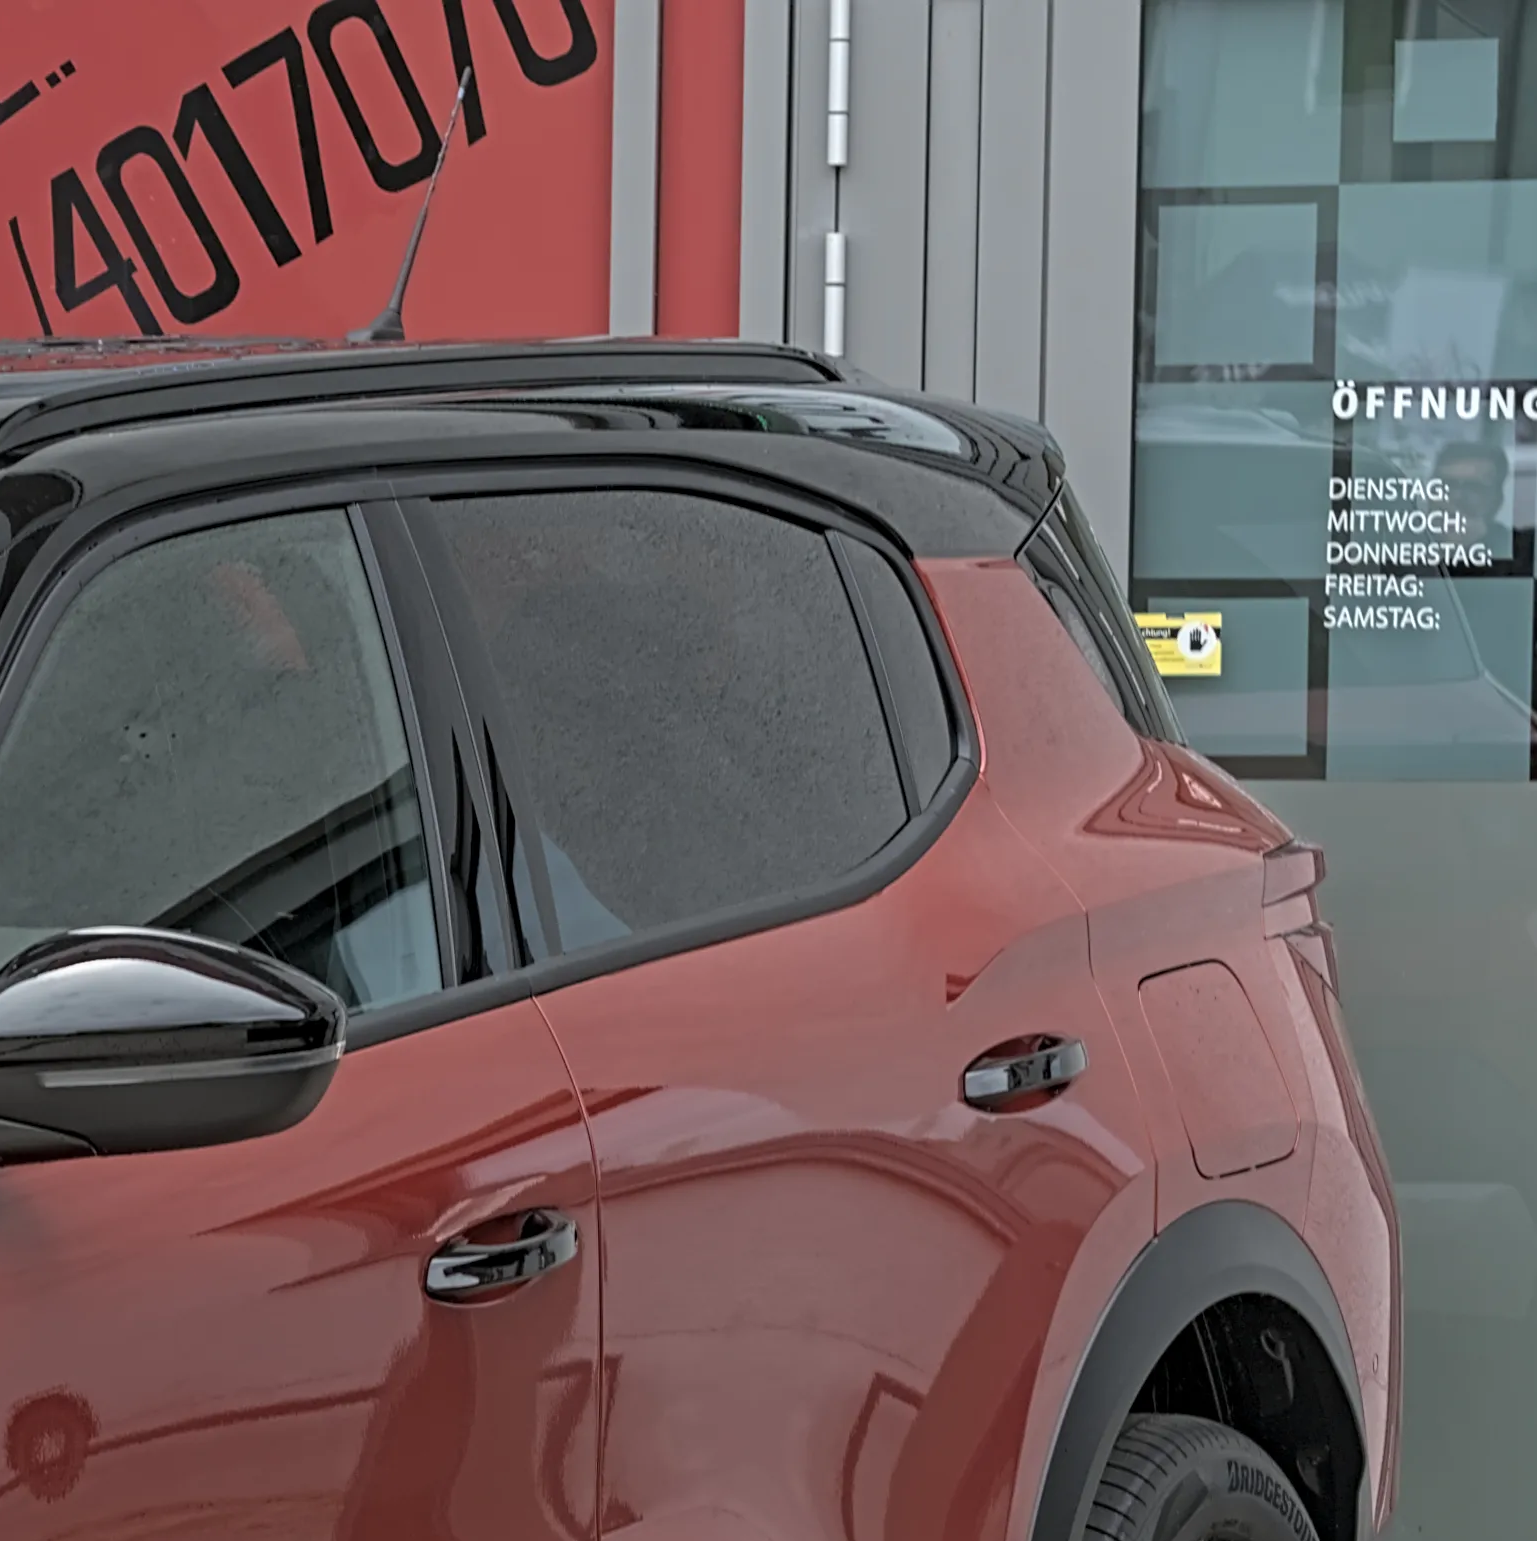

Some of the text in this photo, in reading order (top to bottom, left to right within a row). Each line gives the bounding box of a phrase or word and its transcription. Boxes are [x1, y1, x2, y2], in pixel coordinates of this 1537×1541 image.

[1329, 477, 1450, 501] DIENSTAG:
[1327, 509, 1467, 534] MITTWOCH:
[1326, 541, 1493, 567] DONNERSTAG:
[1325, 575, 1424, 598] FREITAG:
[1323, 606, 1441, 630] SAMSTAG:
